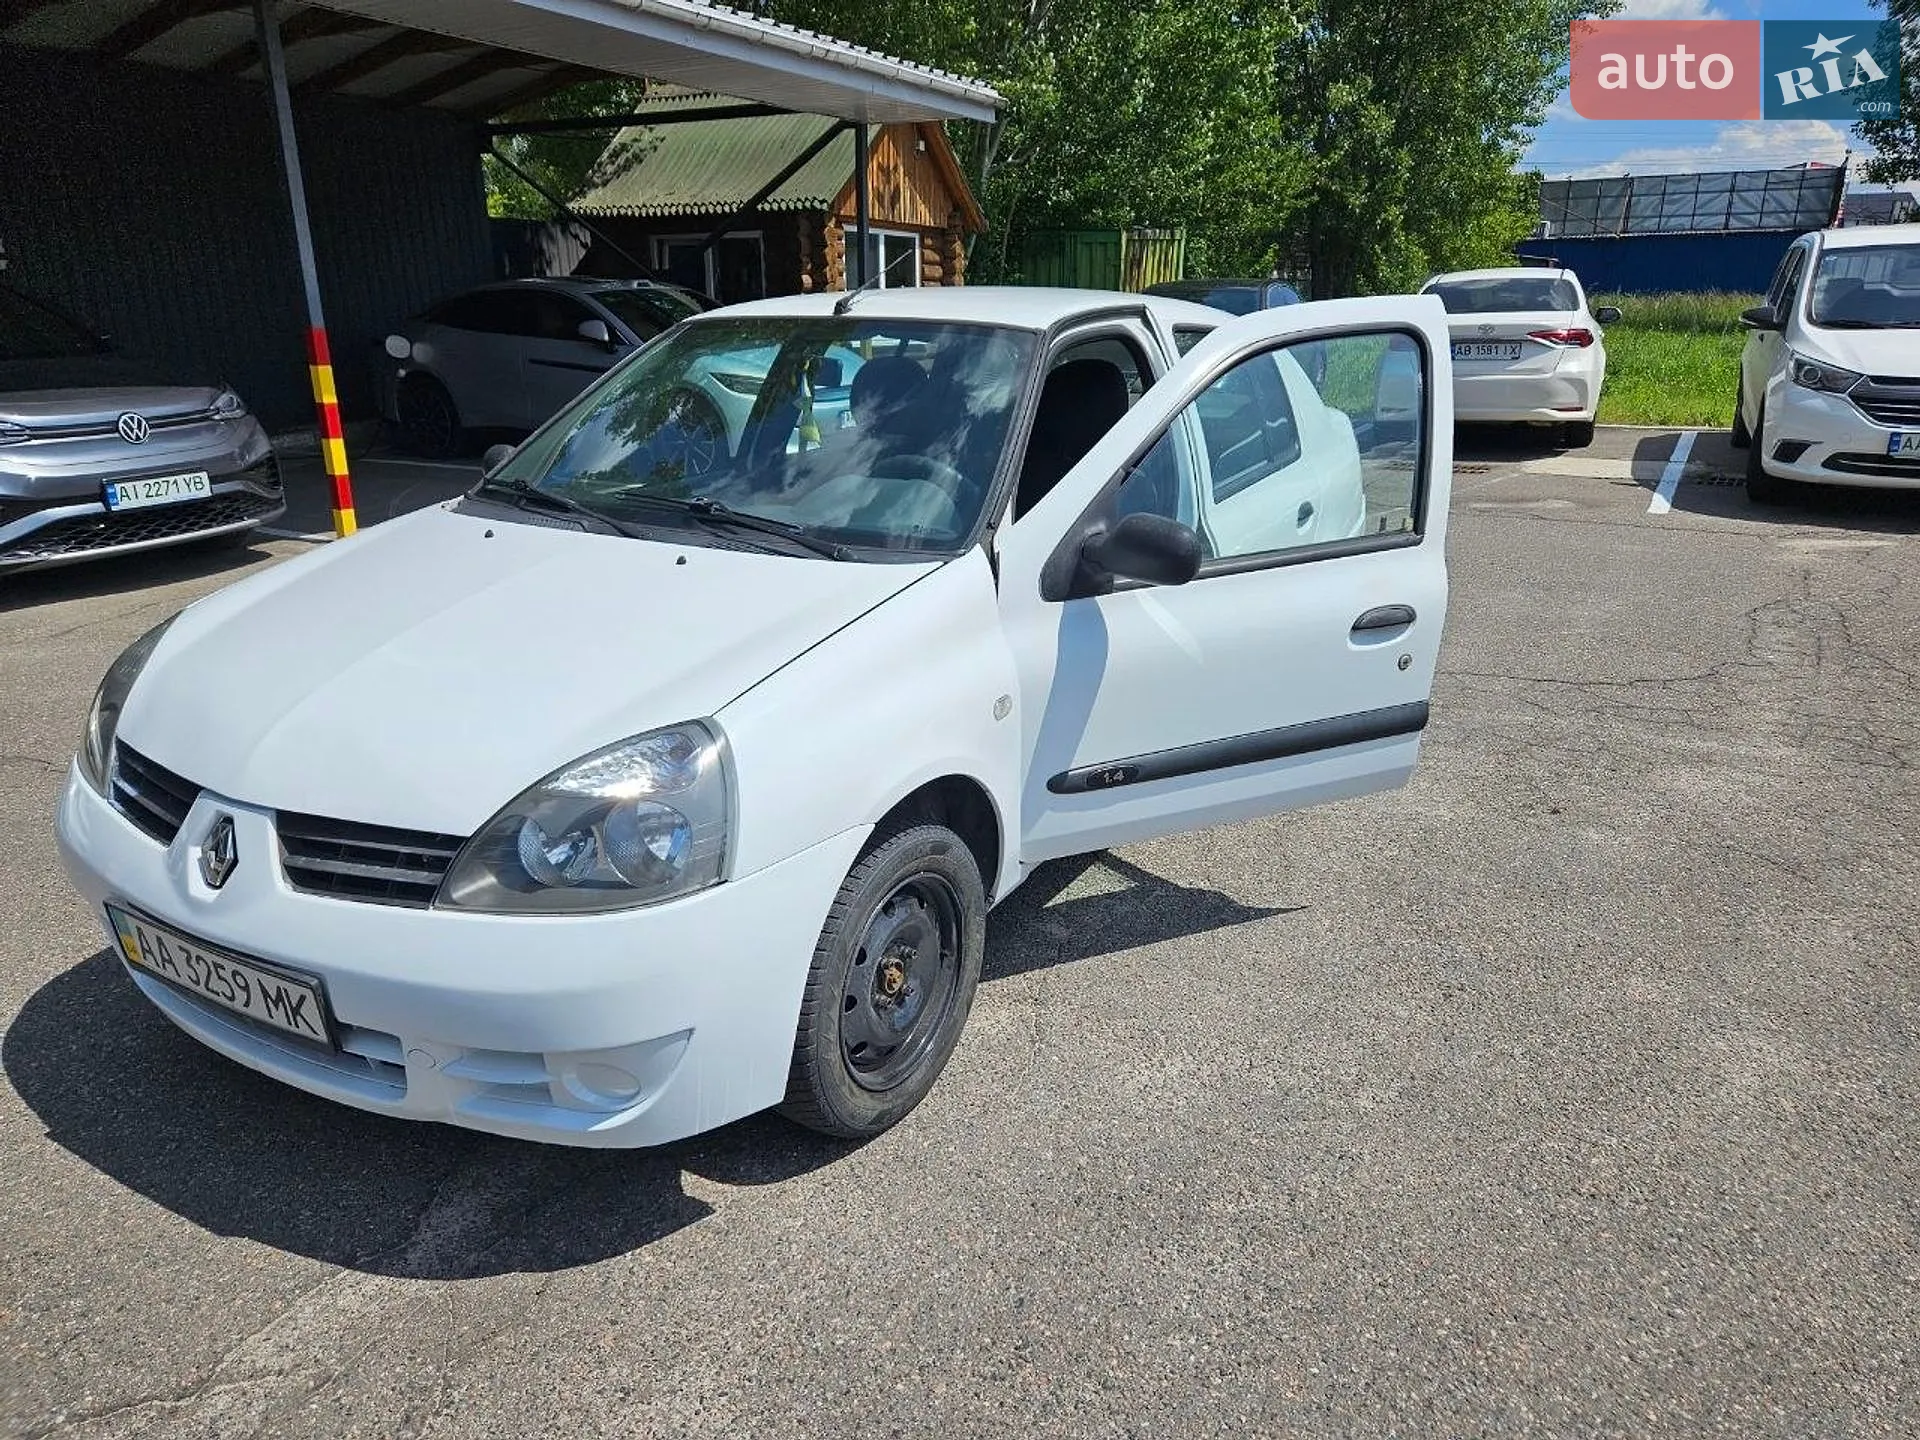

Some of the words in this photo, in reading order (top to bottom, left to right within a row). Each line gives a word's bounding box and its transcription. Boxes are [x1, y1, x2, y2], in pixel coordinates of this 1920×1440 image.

[1456, 345, 1471, 355] AB
[119, 485, 138, 502] AI
[143, 478, 180, 498] 2271
[183, 475, 205, 492] YB
[1103, 769, 1124, 784] 1.4
[135, 924, 181, 978] AA
[178, 945, 251, 1008] 3259
[257, 977, 321, 1036] MK
